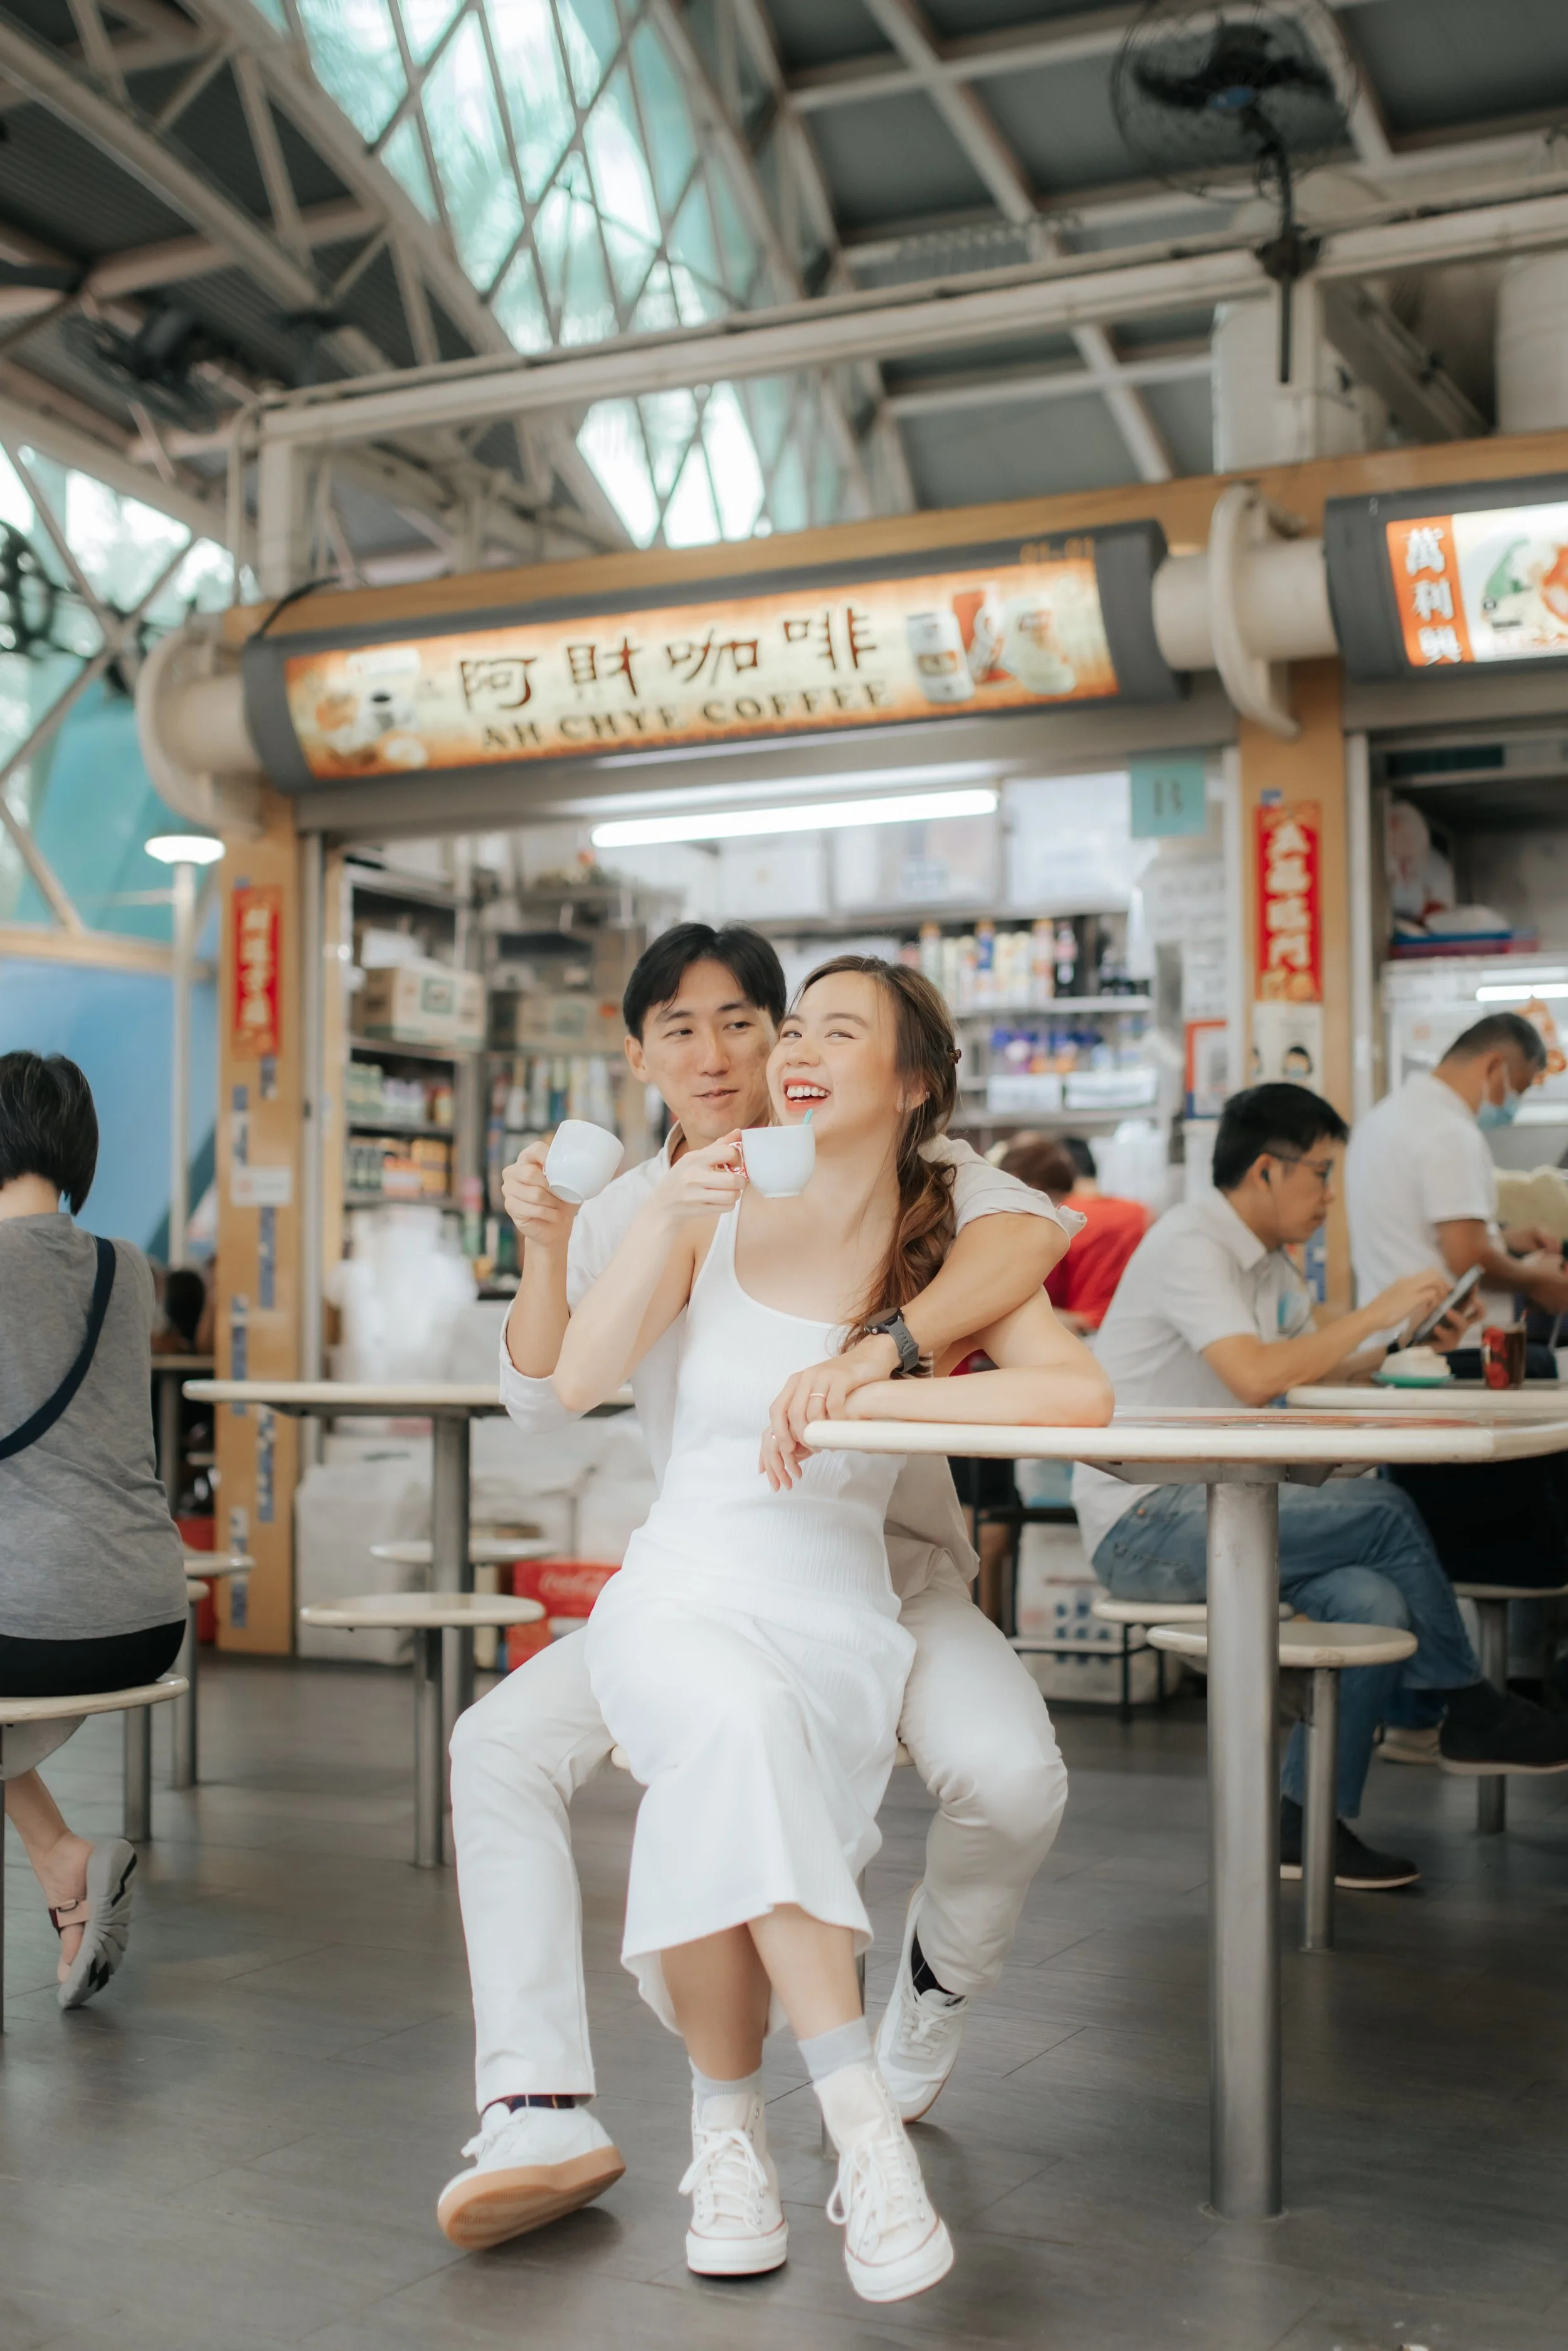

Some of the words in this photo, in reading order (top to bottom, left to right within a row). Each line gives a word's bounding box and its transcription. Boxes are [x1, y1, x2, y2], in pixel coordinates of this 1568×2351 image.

[459, 607, 877, 713] 阿財咖啡
[483, 721, 541, 751] AH
[559, 706, 689, 740] CHYE
[701, 680, 888, 725] COFFEE
